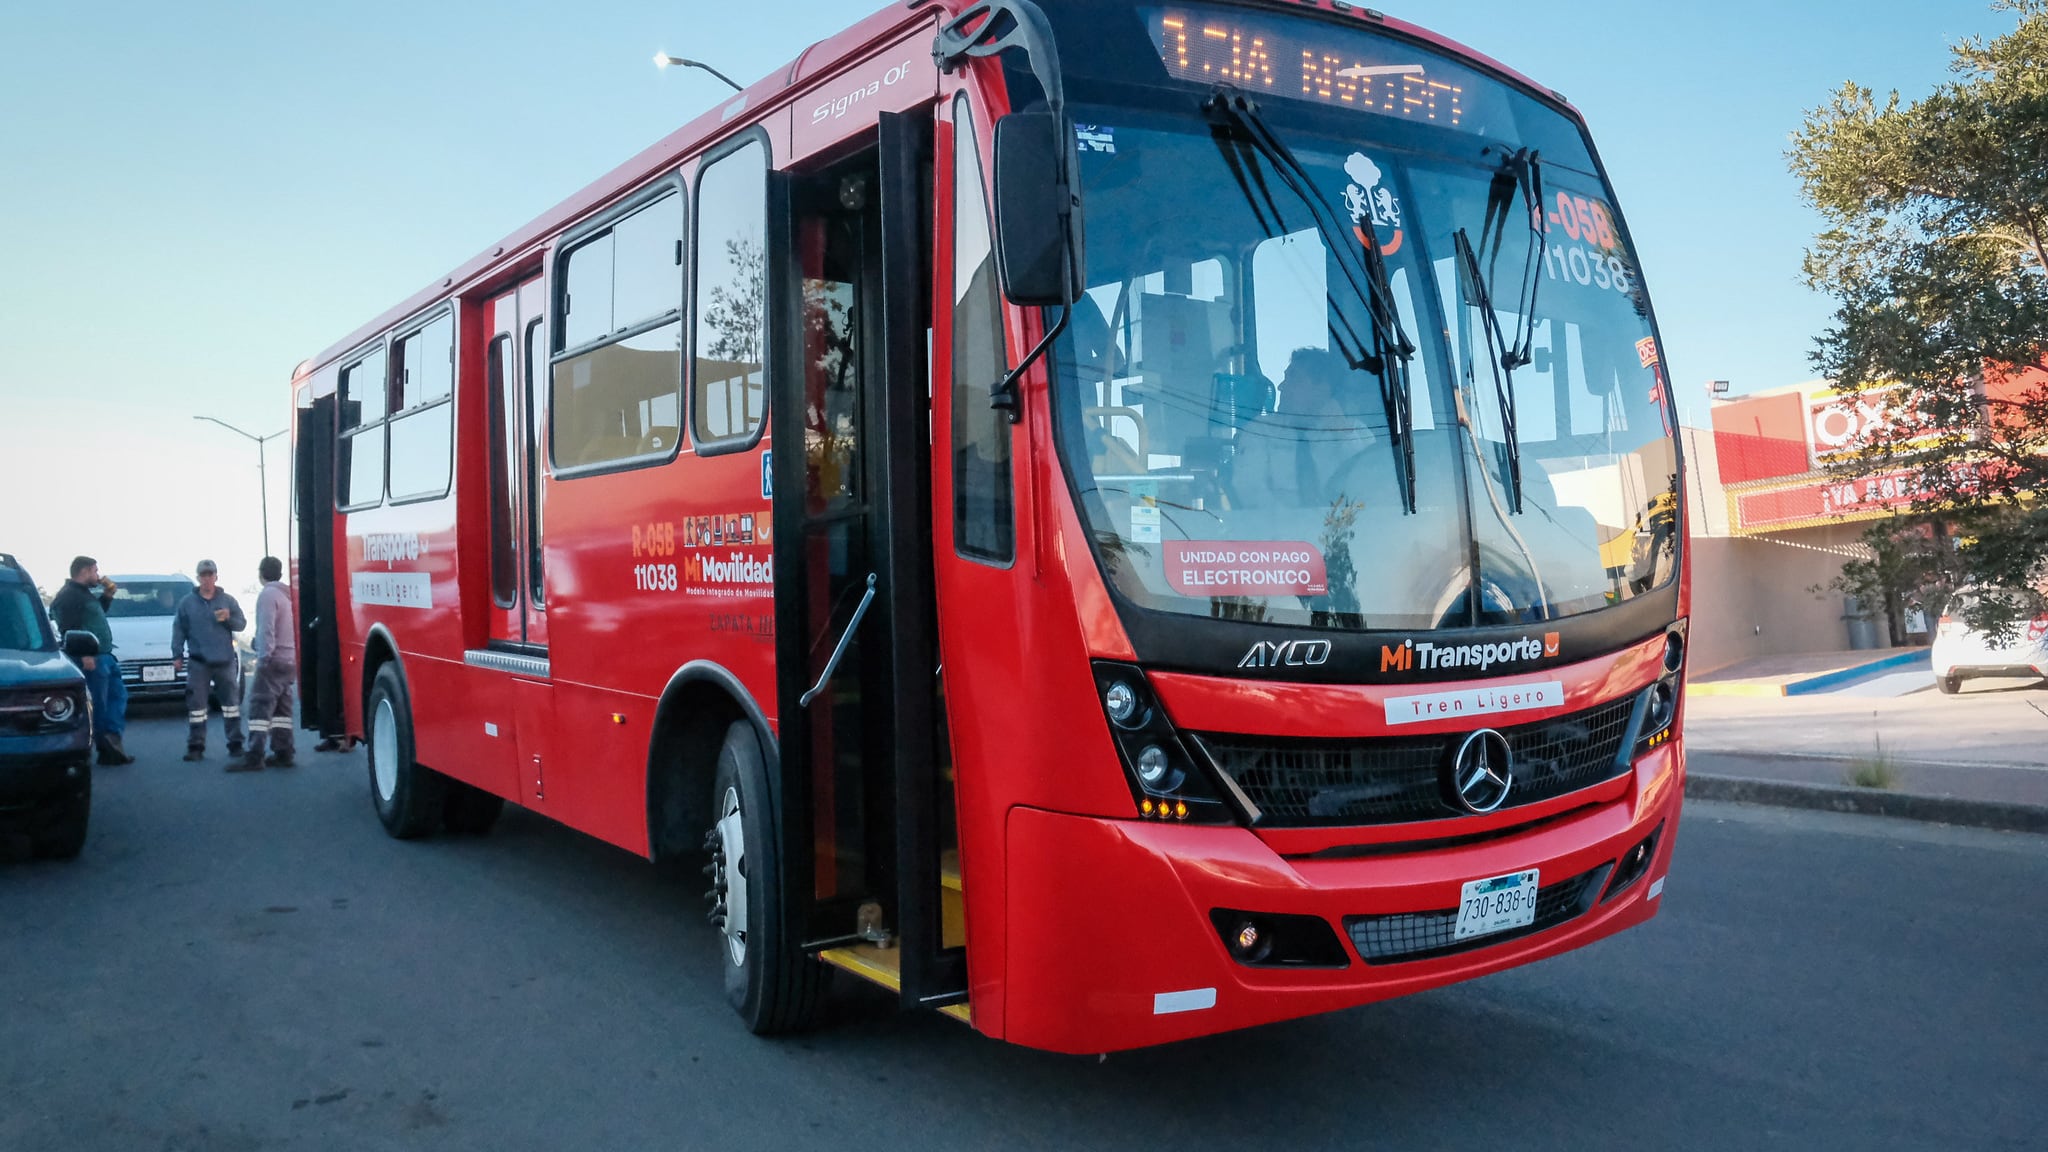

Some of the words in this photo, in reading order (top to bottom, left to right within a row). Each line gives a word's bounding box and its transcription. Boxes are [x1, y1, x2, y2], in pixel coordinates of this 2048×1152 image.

[811, 80, 880, 125] Sigma
[883, 60, 911, 86] OF
[1538, 244, 1630, 293] 11038
[631, 521, 675, 558] R-05B
[684, 552, 700, 582] Mi
[702, 552, 774, 584] Movilidad
[1180, 551, 1236, 564] UNIDAD
[1239, 551, 1270, 564] CON
[1273, 551, 1310, 564] PAGO
[634, 564, 678, 591] 11038
[686, 587, 705, 596] Modelo
[1182, 570, 1311, 586] ELECTRONICO
[1237, 639, 1331, 669] AYCO
[1380, 639, 1412, 672] Mi
[1416, 639, 1541, 671] Transporte
[1411, 697, 1463, 715] Tren
[1477, 689, 1545, 709] Ligero
[1463, 886, 1535, 922] 730-838-G
